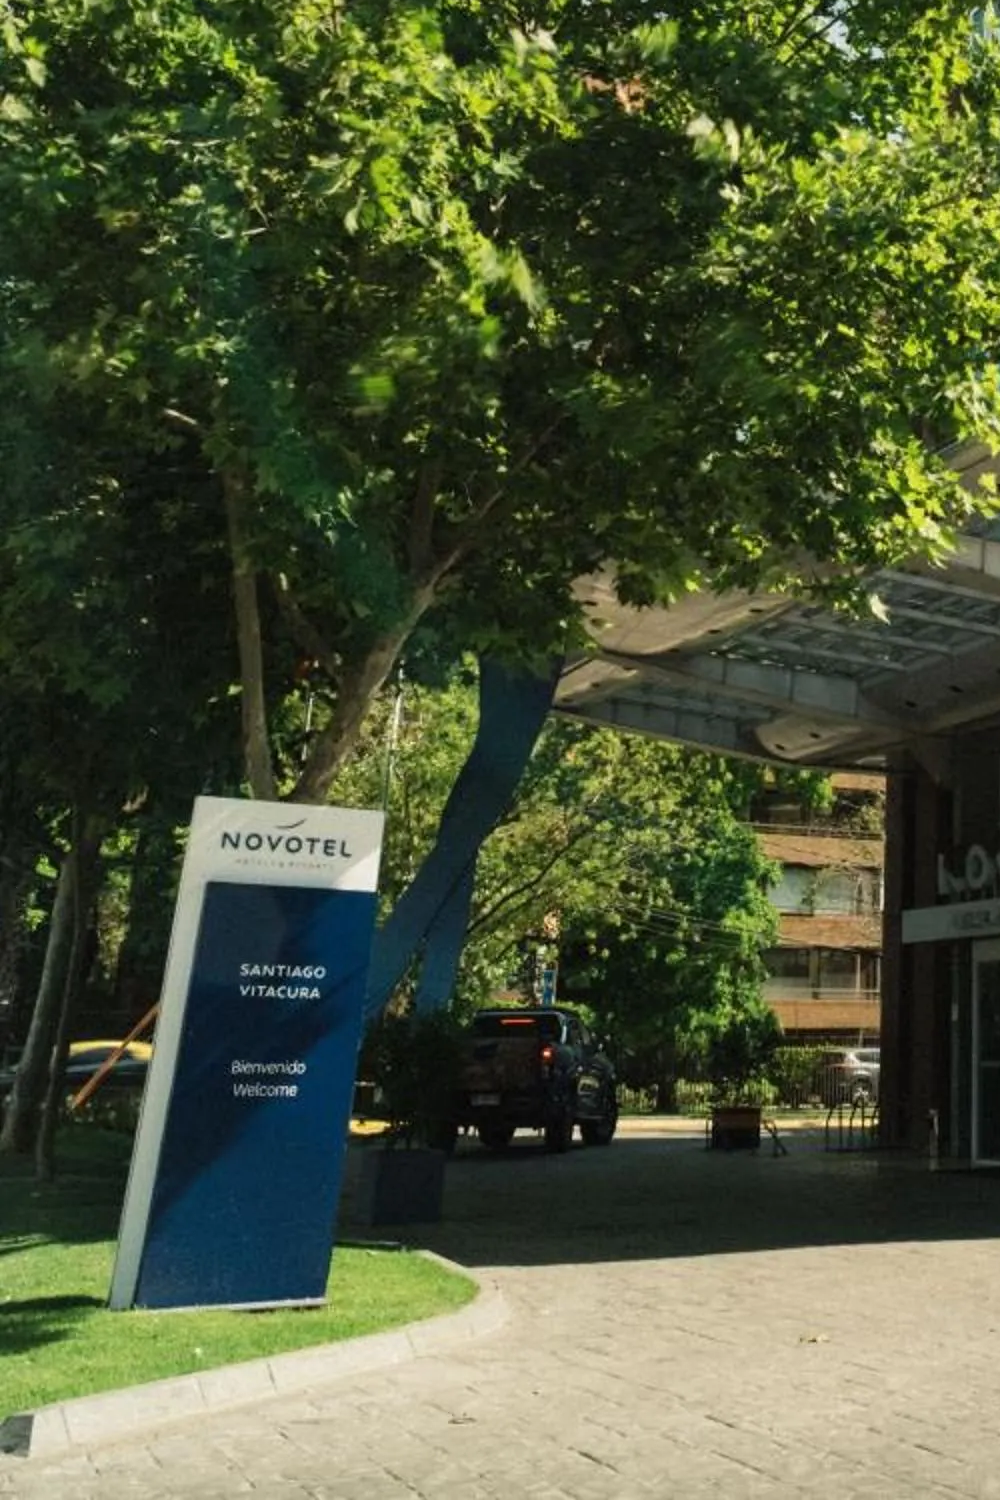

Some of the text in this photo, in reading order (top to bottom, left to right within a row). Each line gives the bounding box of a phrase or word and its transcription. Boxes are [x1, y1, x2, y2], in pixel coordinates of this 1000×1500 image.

[221, 832, 353, 858] NOVOTEL
[239, 963, 327, 979] SANTIAGO
[239, 985, 321, 999] VITACURA
[231, 1060, 307, 1075] Bienvenido
[233, 1083, 298, 1097] Welcome
